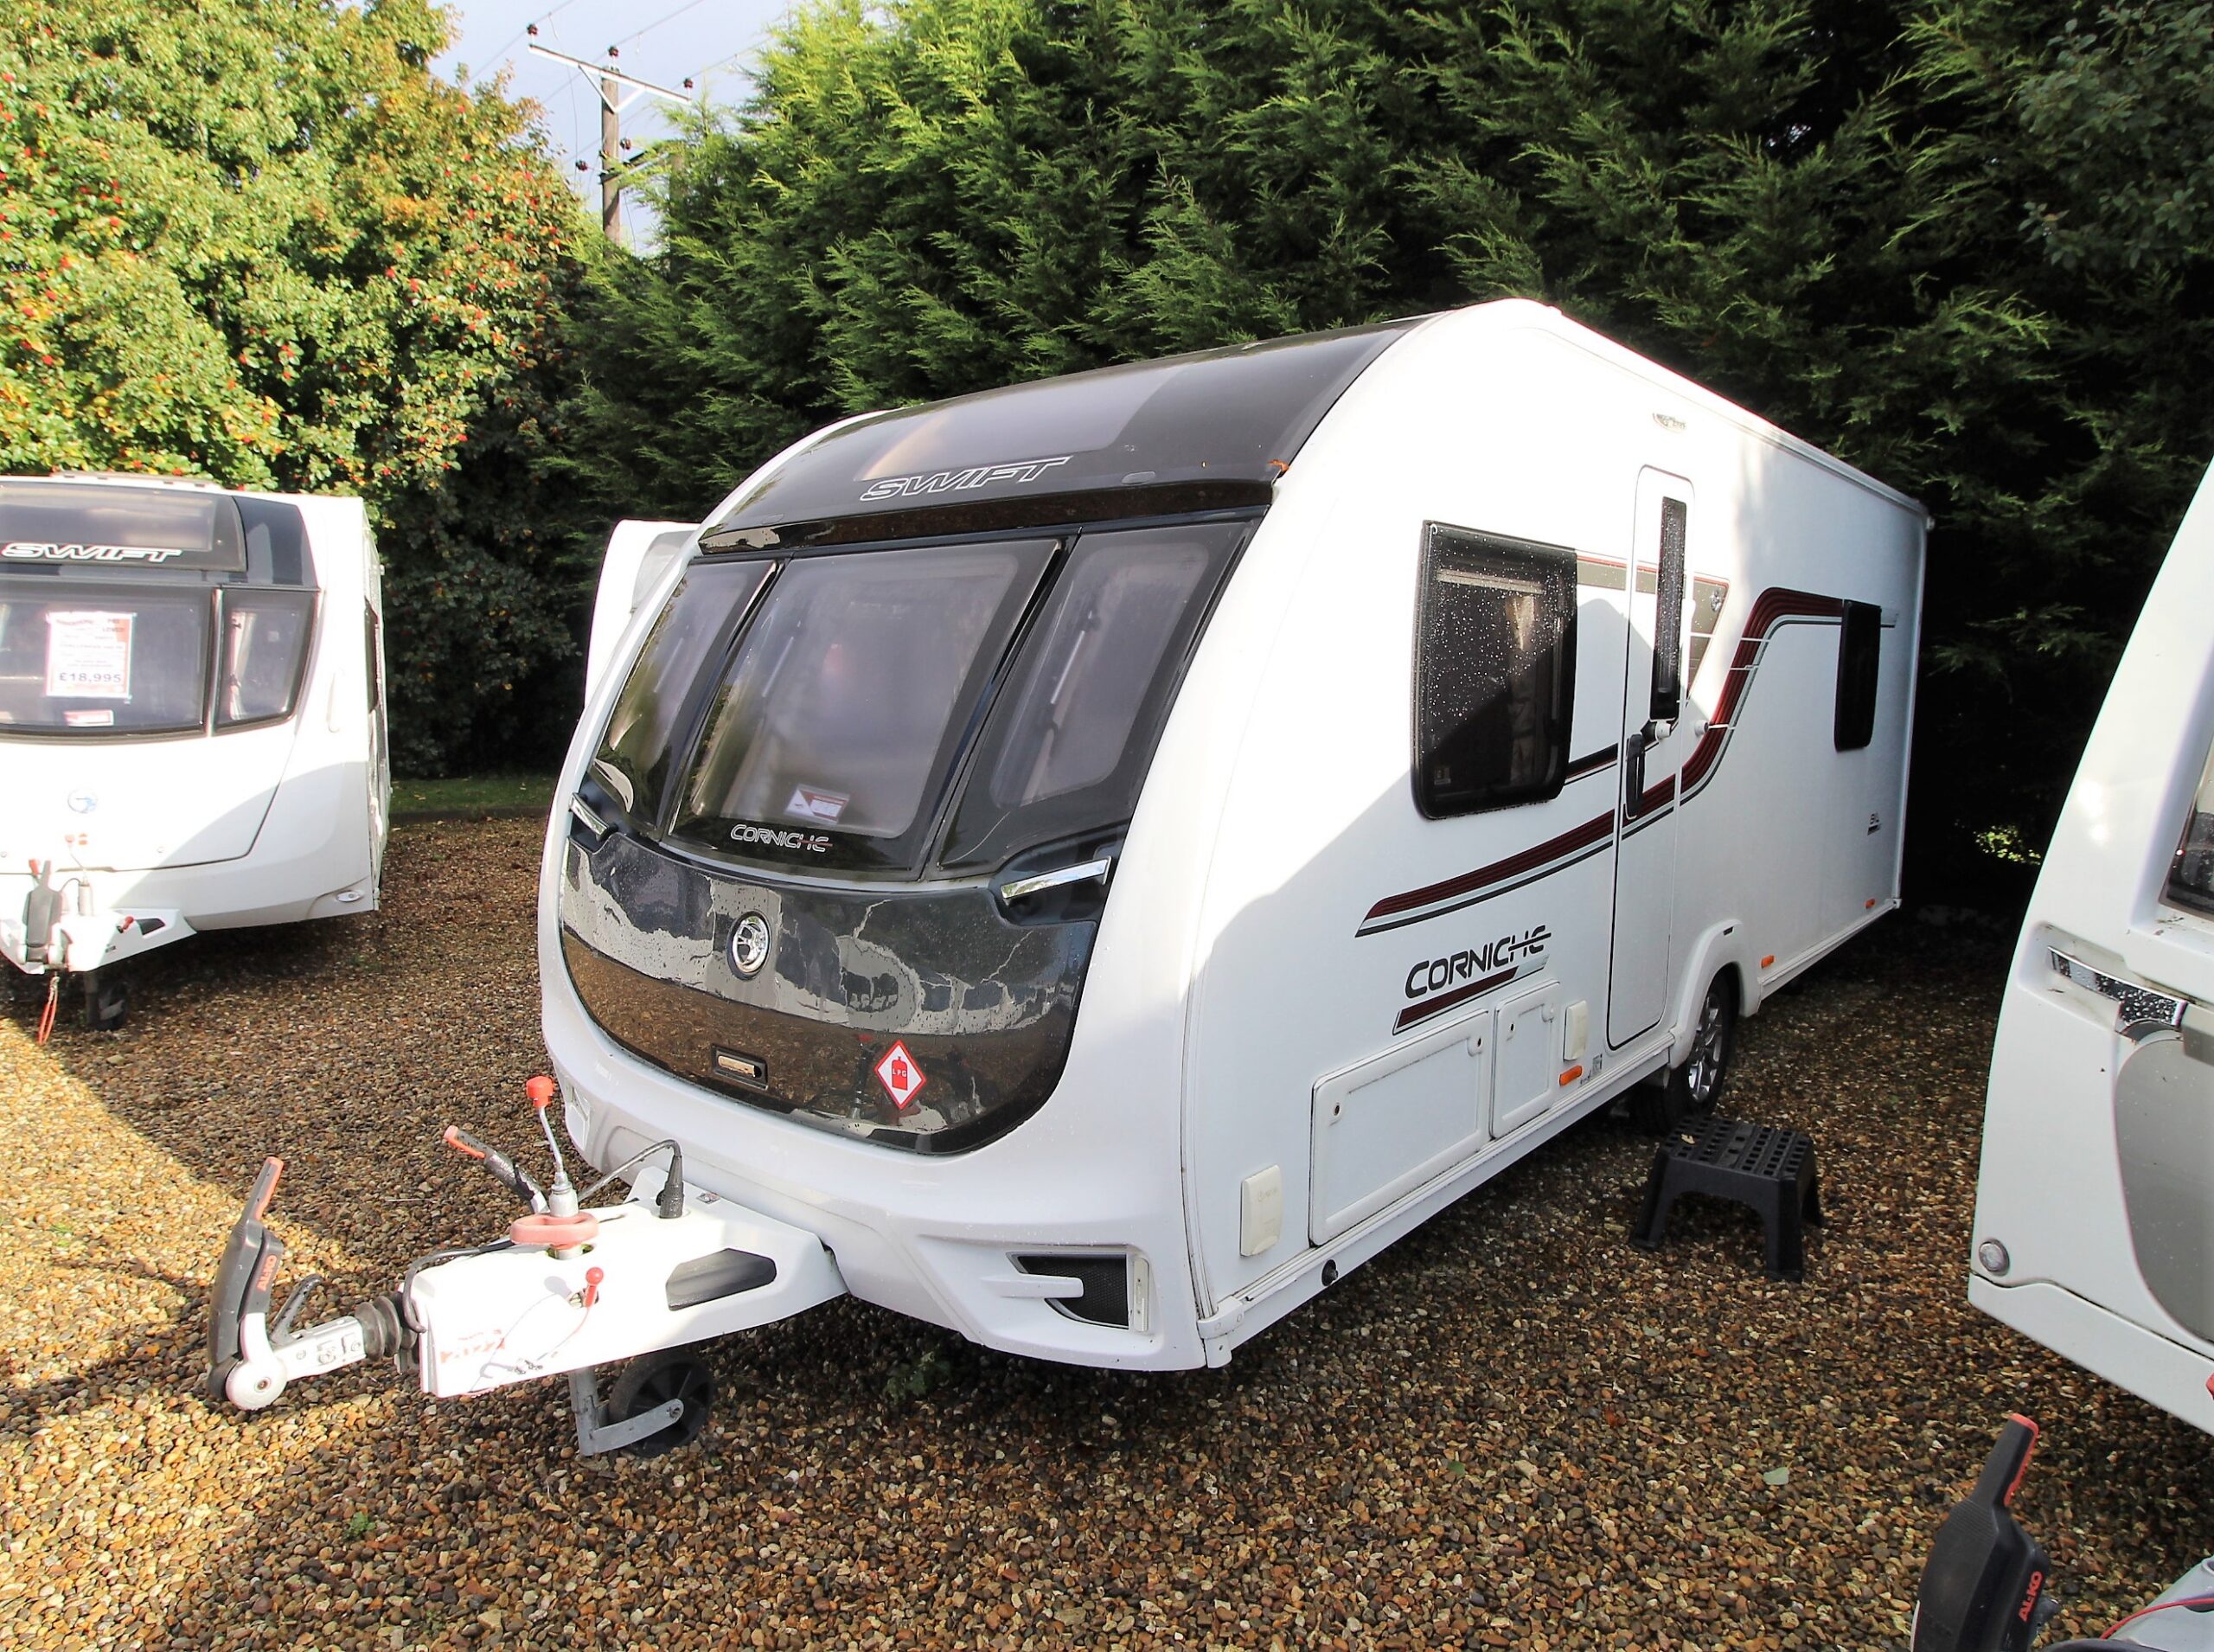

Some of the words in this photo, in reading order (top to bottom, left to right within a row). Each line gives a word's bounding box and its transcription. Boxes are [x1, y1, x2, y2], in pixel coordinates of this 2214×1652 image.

[860, 455, 1073, 502] SWIFT
[1, 541, 182, 563] SWIFT
[730, 823, 833, 852] CORNICHE
[1405, 925, 1552, 999] CORNICHE
[892, 1067, 907, 1078] LPG
[2018, 1570, 2044, 1623] AL-KO
